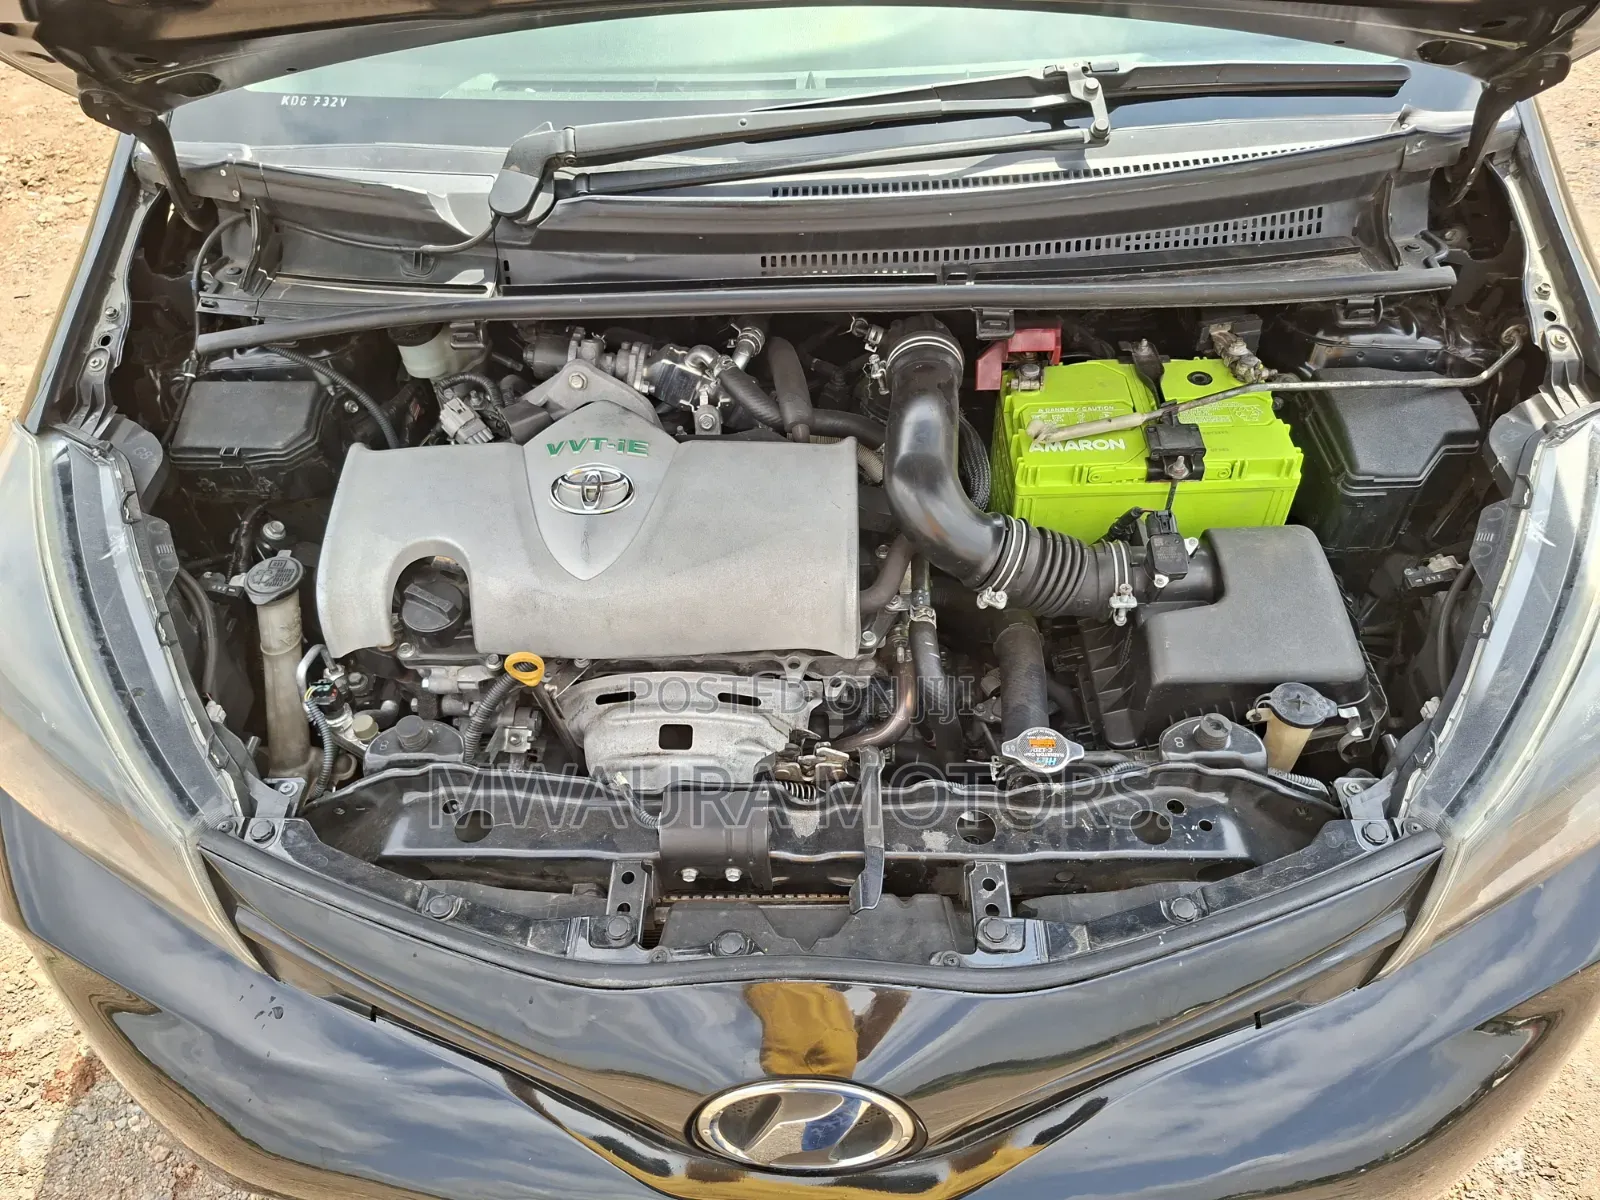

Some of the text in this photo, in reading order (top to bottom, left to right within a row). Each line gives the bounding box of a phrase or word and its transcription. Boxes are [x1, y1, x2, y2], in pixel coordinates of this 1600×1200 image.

[280, 95, 347, 107] KDG 732V
[546, 437, 649, 457] VVT-iE
[1029, 438, 1126, 453] AMARON
